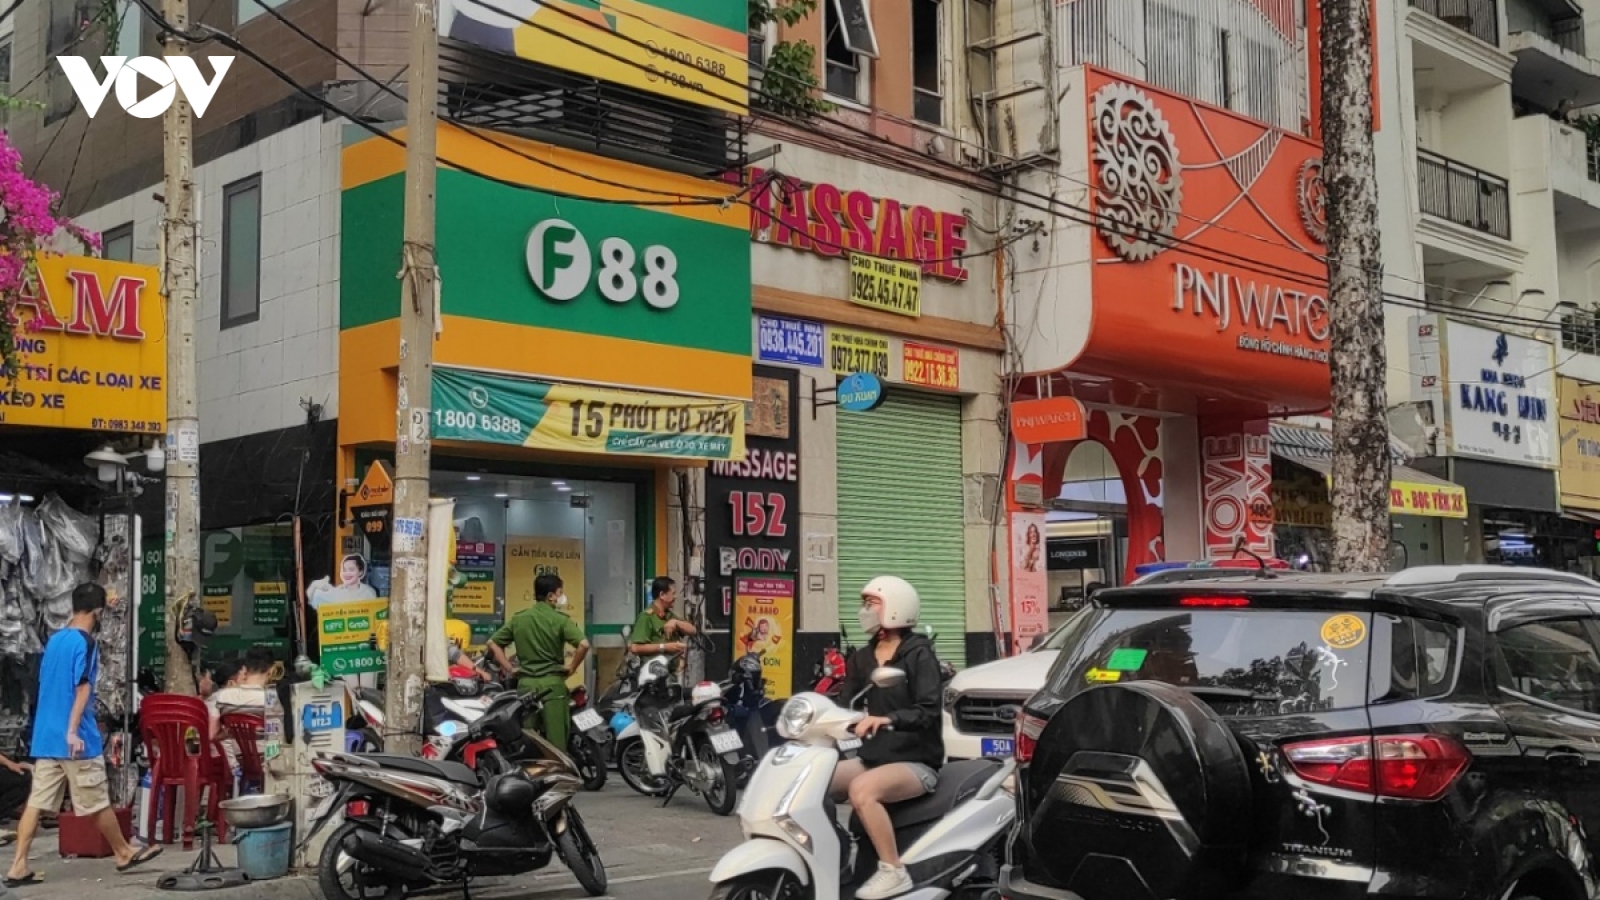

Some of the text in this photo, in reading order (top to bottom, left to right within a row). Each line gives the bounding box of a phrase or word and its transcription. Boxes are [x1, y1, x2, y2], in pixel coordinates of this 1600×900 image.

[851, 255, 871, 269] CHO
[851, 271, 918, 312] 0925.45.47.47
[1172, 262, 1330, 342] PNJ WATC
[57, 366, 91, 384] CÁC
[95, 373, 133, 392] LOẠI
[139, 375, 162, 390] XE
[40, 393, 65, 409] XE
[435, 408, 521, 434] 1800 6388
[569, 398, 737, 438] 15 PHÚT CÓ TIỀN
[712, 448, 798, 482] MASSAGE
[728, 491, 787, 537] 152
[719, 547, 792, 577] BODY
[347, 655, 389, 668] 1800 63
[1282, 842, 1353, 857] TITANIUM
